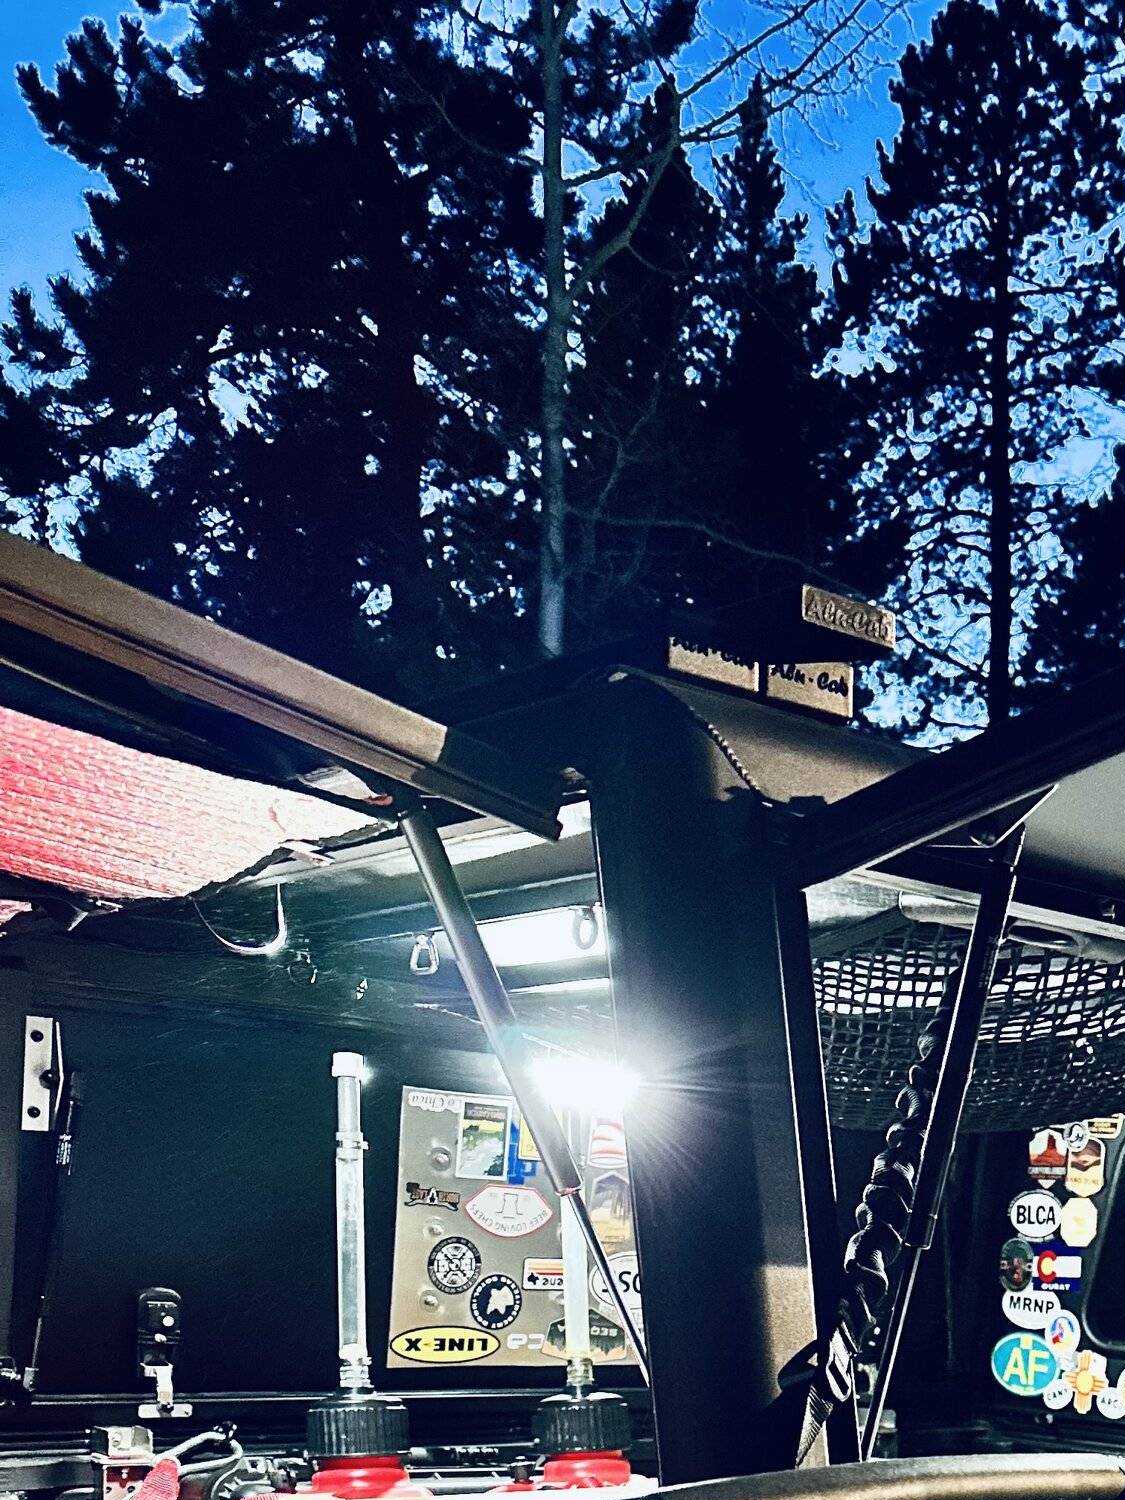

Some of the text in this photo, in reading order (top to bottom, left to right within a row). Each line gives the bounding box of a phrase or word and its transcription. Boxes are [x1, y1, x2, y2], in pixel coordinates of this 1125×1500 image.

[1016, 1204, 1056, 1226] BLCA
[1009, 1295, 1055, 1315] MRNP
[404, 1337, 489, 1352] LINE-X
[1002, 1346, 1050, 1386] AF
